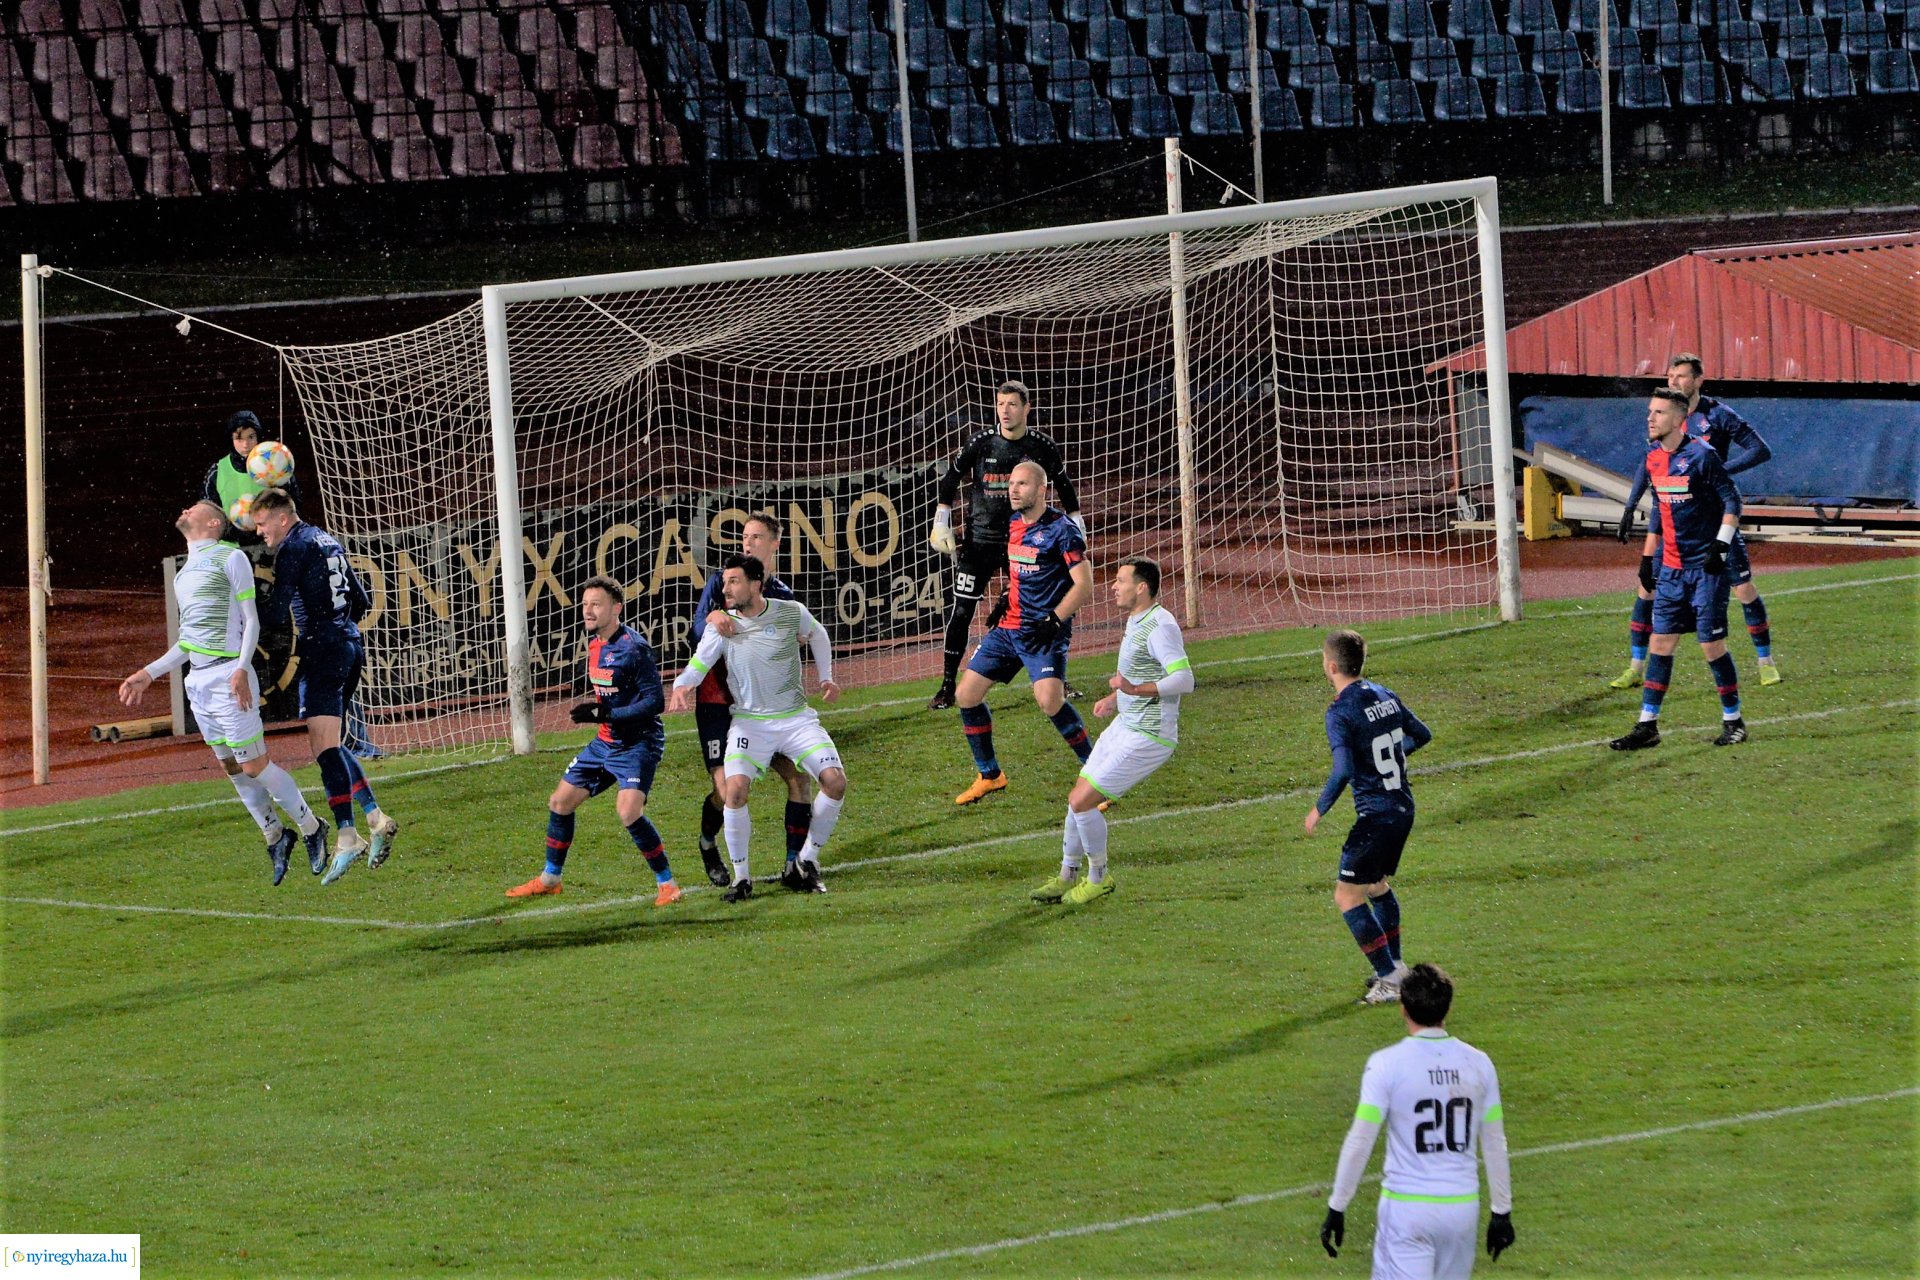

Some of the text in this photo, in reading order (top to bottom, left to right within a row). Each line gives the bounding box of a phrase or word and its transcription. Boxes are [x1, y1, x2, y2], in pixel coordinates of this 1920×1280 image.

[956, 572, 977, 593] 95
[838, 572, 945, 626] 0-24
[707, 739, 721, 760] 18
[736, 737, 749, 750] 19
[1427, 1064, 1460, 1086] TÓTH
[1414, 1096, 1474, 1154] 20
